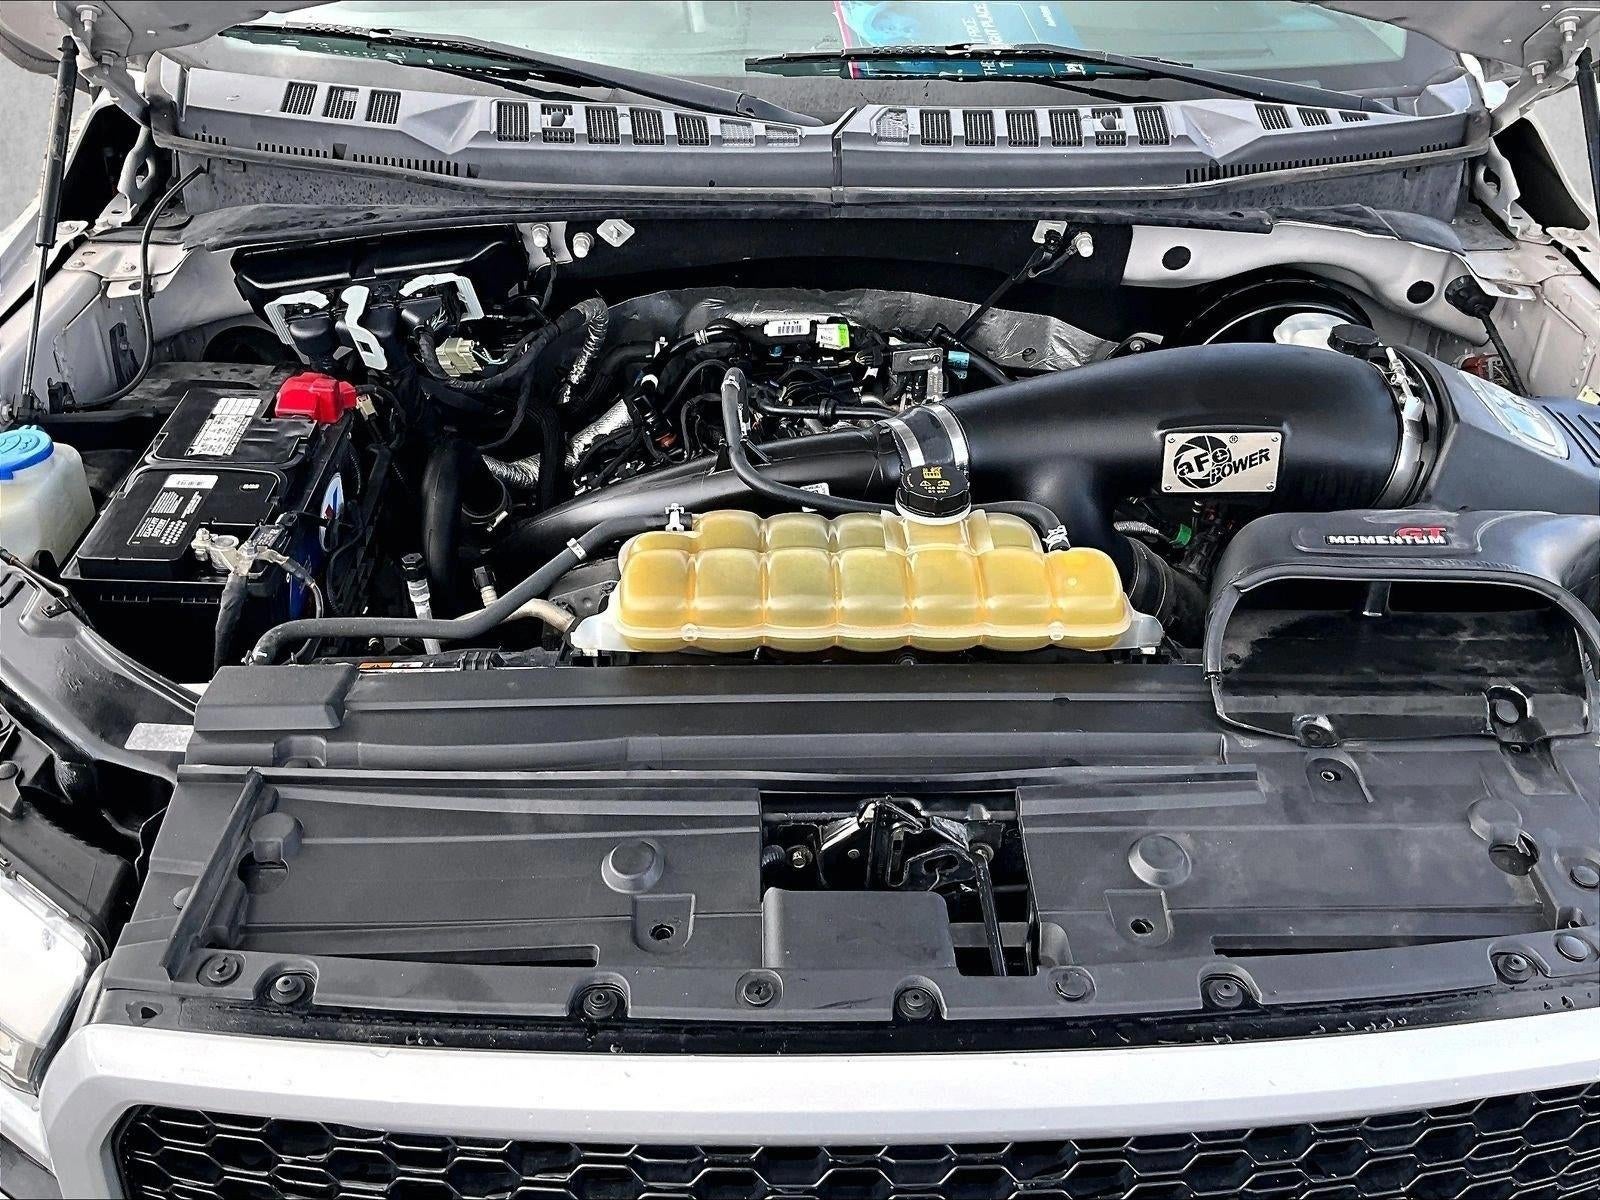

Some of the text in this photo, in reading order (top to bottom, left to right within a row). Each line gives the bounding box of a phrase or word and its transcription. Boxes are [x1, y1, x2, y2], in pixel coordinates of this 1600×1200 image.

[1178, 448, 1229, 478] aFe
[1209, 448, 1271, 484] POWER
[1328, 535, 1446, 545] MOMENTUM
[1395, 527, 1446, 538] GT
